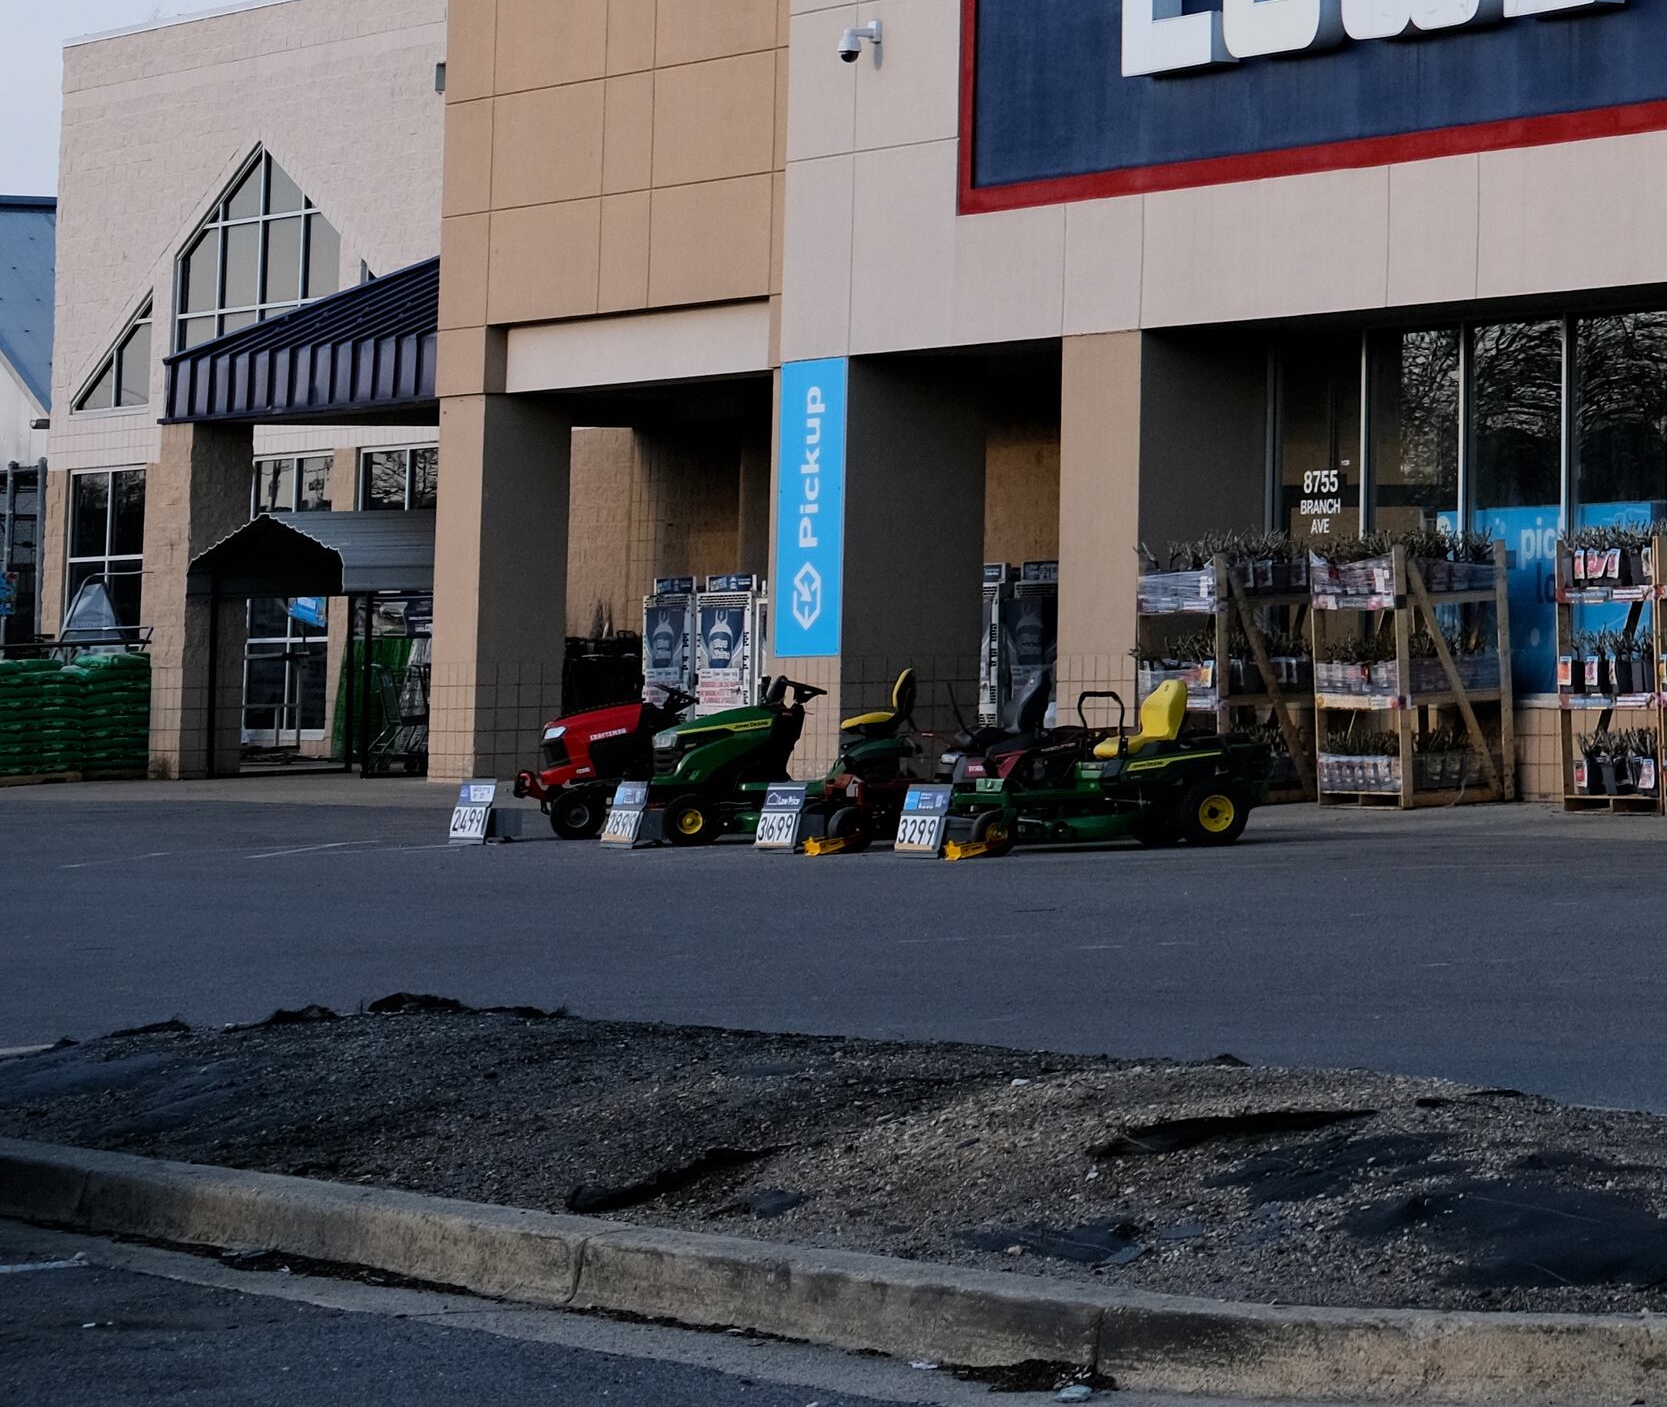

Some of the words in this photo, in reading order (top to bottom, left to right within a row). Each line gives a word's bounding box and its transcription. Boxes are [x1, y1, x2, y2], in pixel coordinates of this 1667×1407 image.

[799, 385, 826, 548] Pickup
[1303, 469, 1339, 494] 8755
[1300, 497, 1341, 515] BRANCH
[1310, 518, 1330, 534] AVE
[898, 818, 936, 845] 3299
